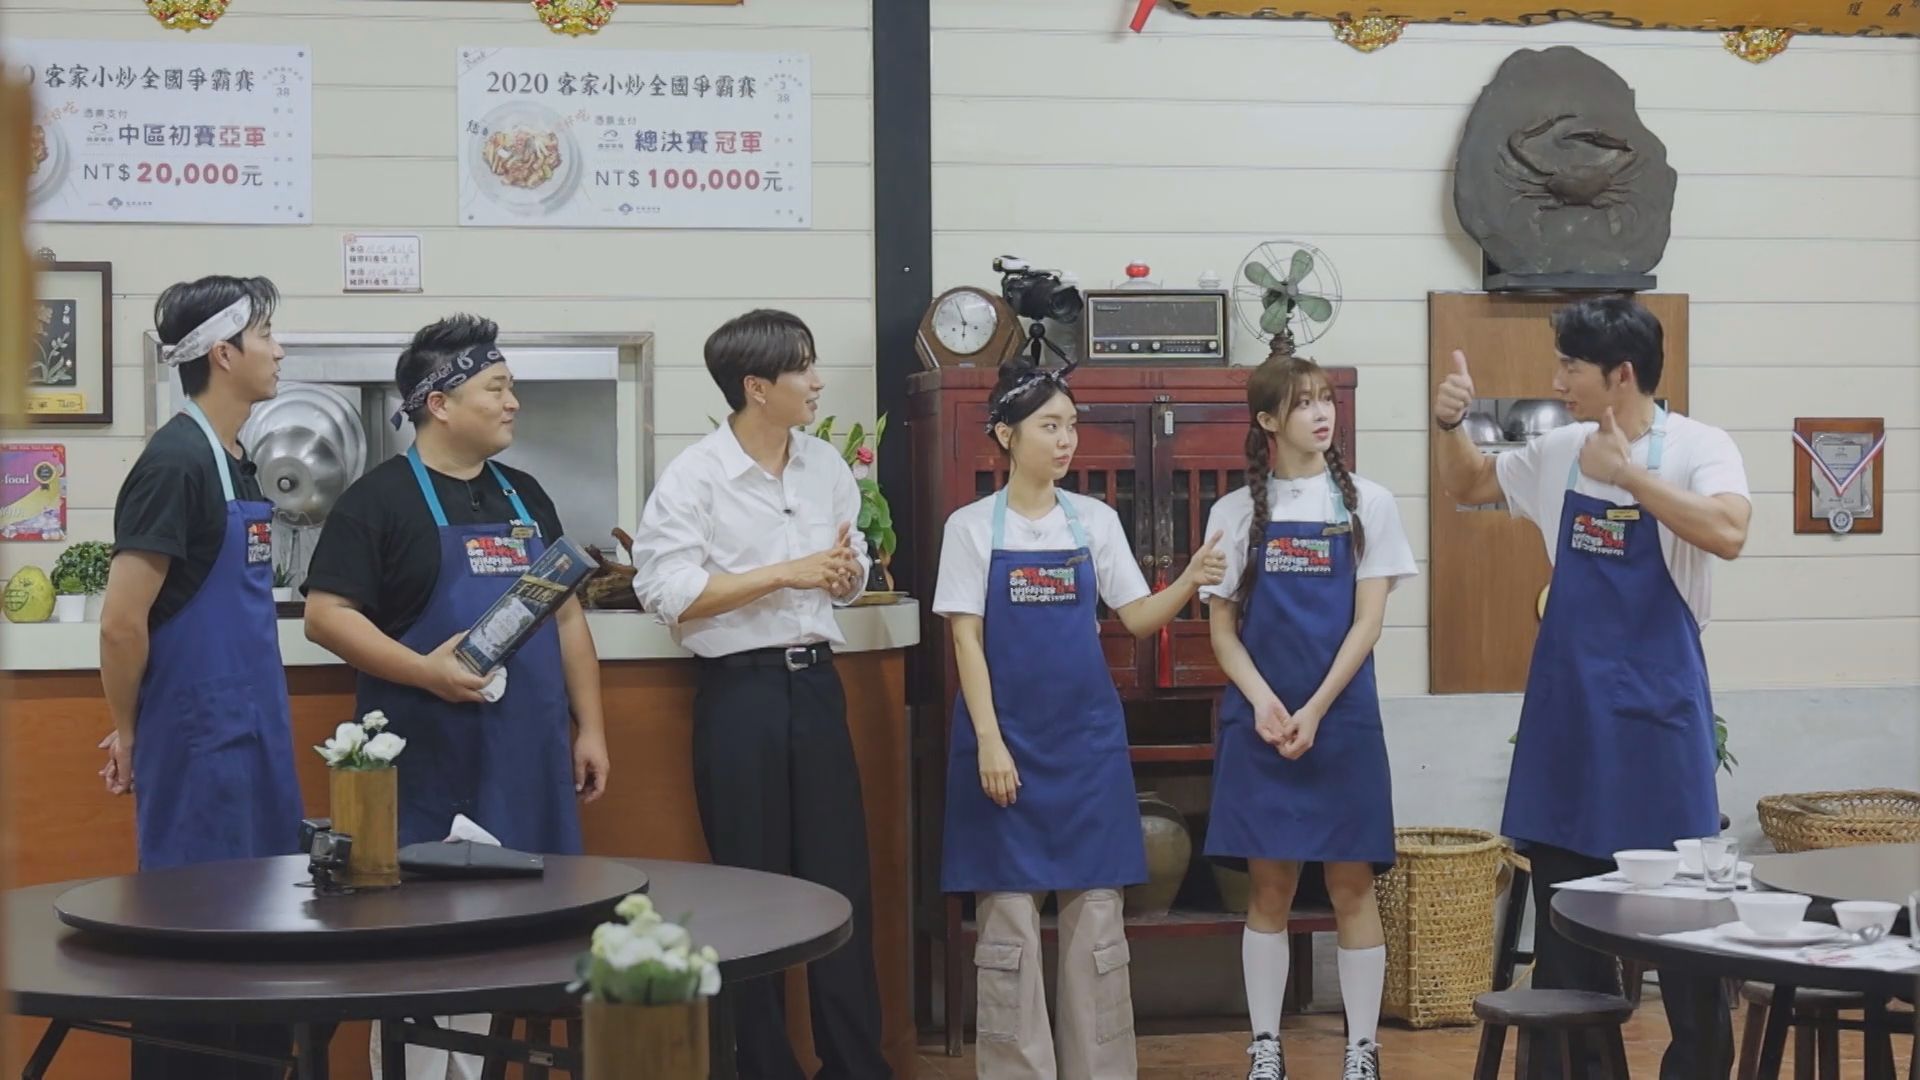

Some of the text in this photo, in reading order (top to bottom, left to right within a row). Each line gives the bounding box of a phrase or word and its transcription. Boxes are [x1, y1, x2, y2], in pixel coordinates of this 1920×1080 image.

[44, 63, 256, 92] 客家小炒全國爭霸賽
[486, 71, 549, 95] 2020
[556, 71, 757, 99] 客家小炒全國爭霸賽
[118, 123, 266, 148] 中區初賽亞軍
